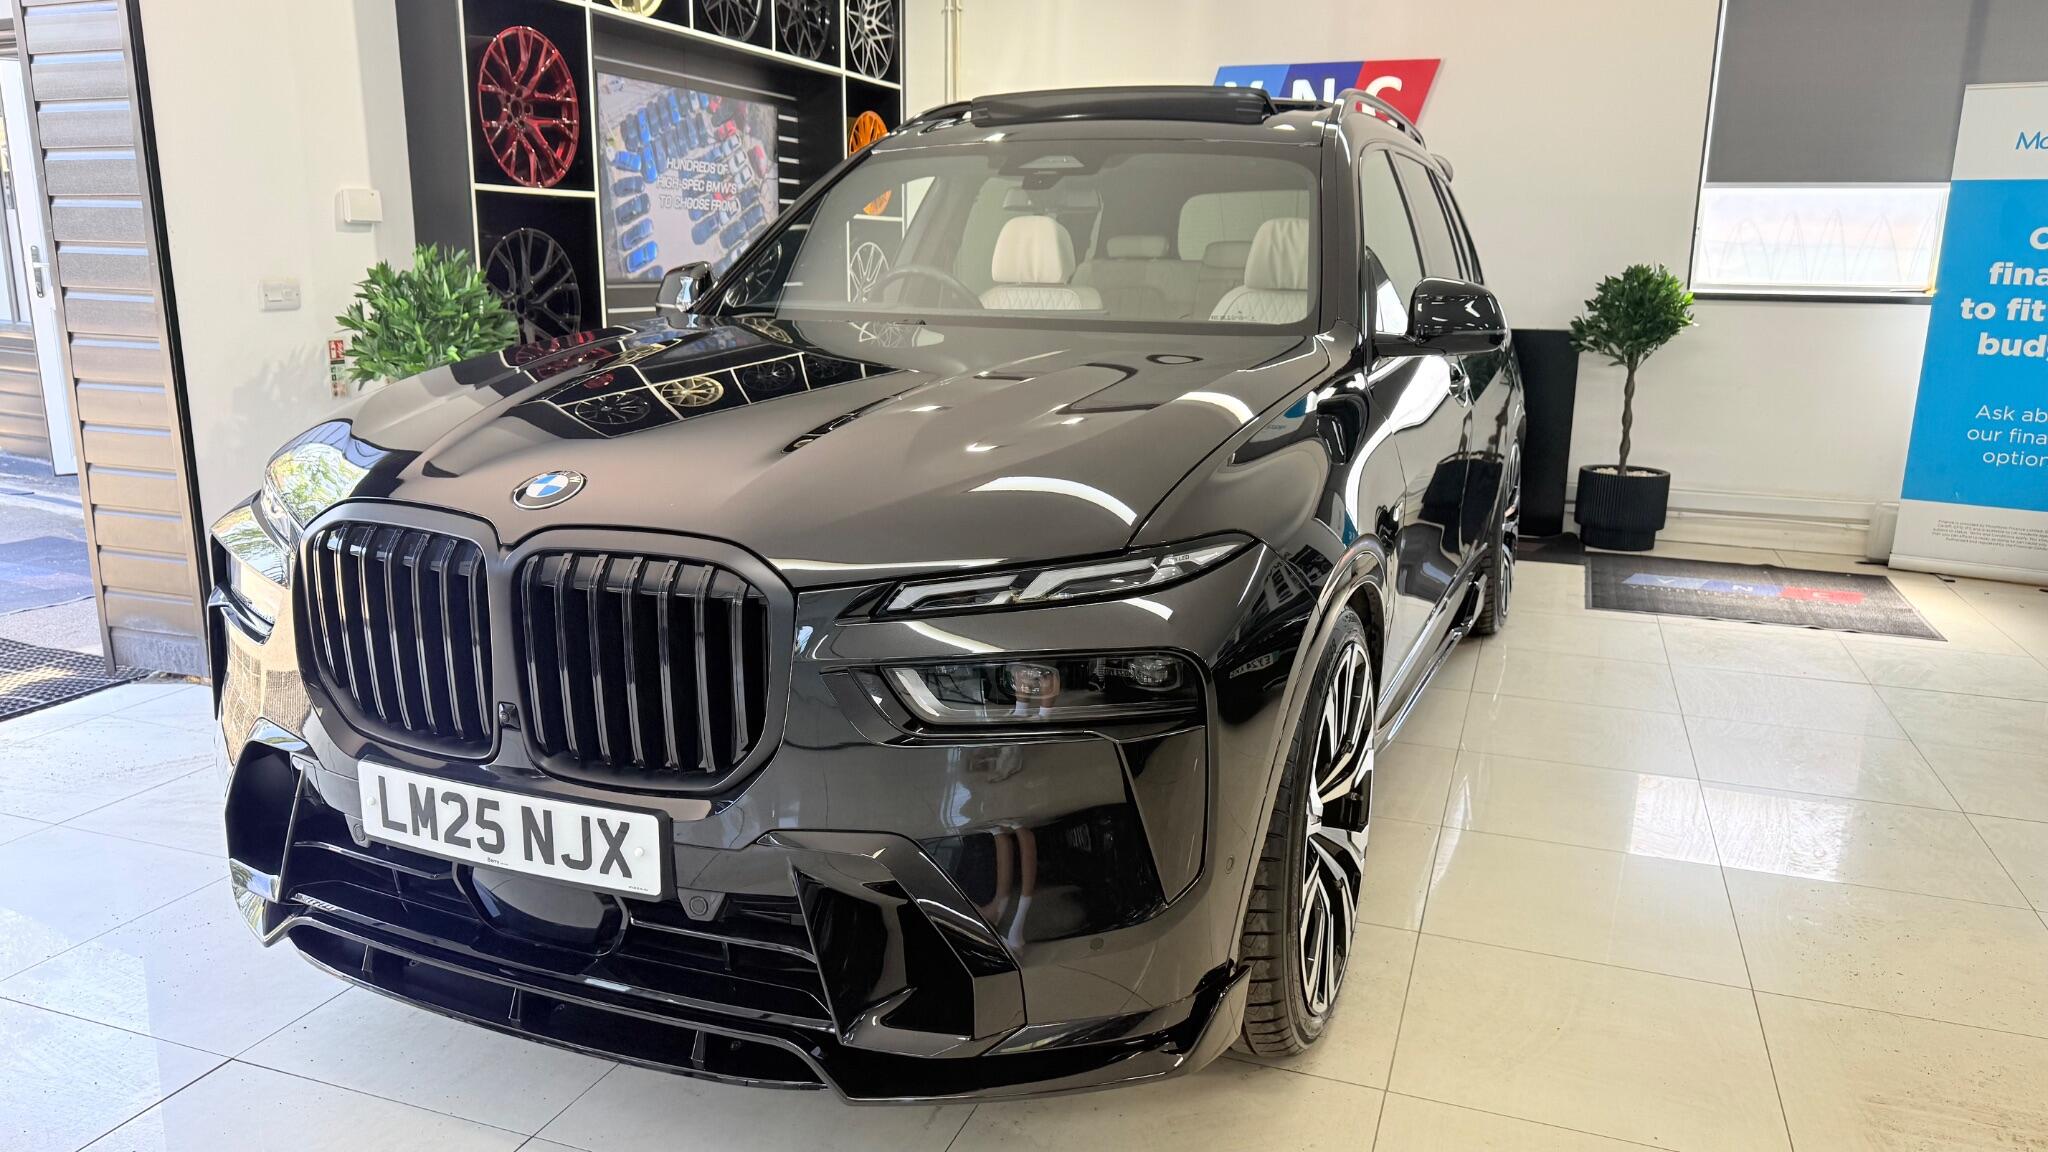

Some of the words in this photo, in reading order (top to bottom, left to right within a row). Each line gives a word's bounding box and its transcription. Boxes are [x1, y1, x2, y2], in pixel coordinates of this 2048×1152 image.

[1224, 76, 1402, 128] NC
[666, 157, 716, 174] HUNDREDS
[717, 163, 728, 175] OF
[1960, 298, 1996, 320] to
[2006, 297, 2046, 322] fit
[1977, 332, 2048, 361] bud
[1975, 404, 2015, 421] Ask
[2021, 408, 2048, 423] ab
[1967, 429, 2003, 442] our
[2009, 428, 2047, 445] fina
[377, 775, 506, 854] LM25
[520, 805, 633, 879] NJX
